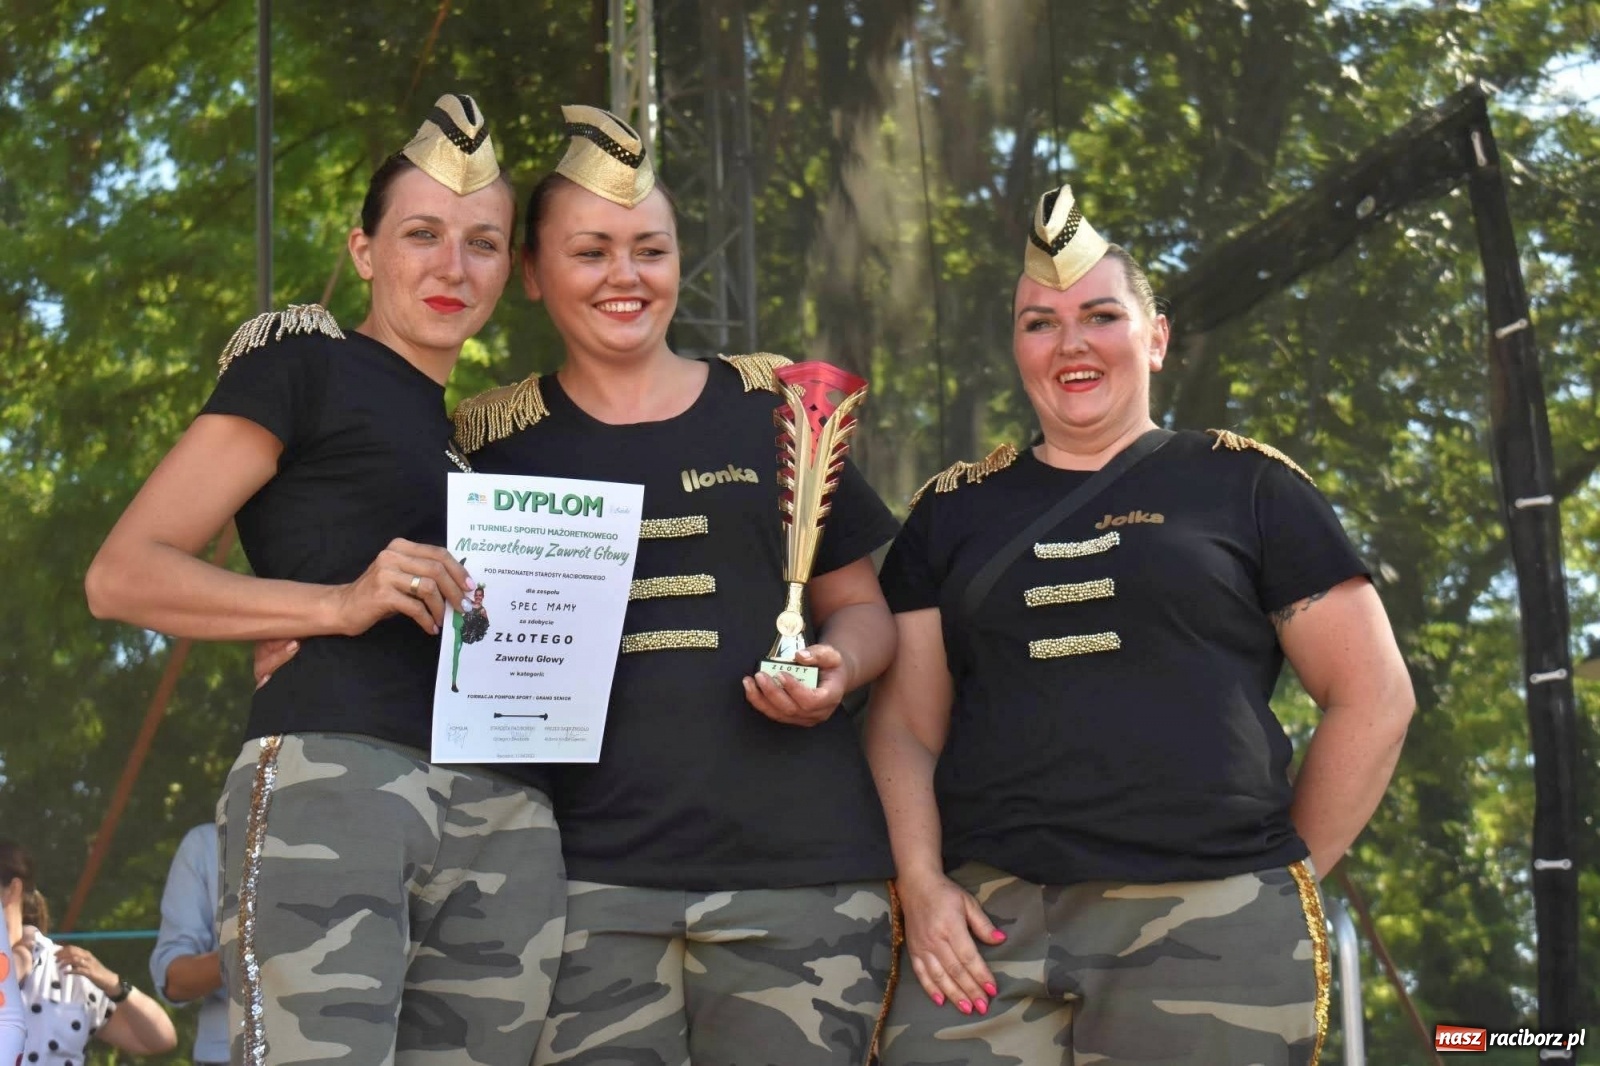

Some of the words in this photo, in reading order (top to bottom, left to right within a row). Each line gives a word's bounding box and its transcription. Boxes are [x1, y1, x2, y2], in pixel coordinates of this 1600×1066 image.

[681, 464, 759, 492] Ilonka
[494, 489, 604, 518] DYPLOM
[1095, 510, 1164, 529] Jolka
[477, 524, 512, 533] TURNIEJ
[514, 526, 546, 535] SPORTU
[547, 527, 618, 540] MAŻORETKOWEGO
[455, 537, 544, 560] Mażoretkowy
[545, 543, 591, 559] Zawrót
[594, 546, 630, 566] Głowy
[498, 569, 534, 577] PATRONATEM
[534, 571, 561, 579] STAROSTY
[562, 572, 606, 581] RACIBORSKIEGO
[510, 600, 538, 611] SPEC
[546, 602, 577, 612] MAMY
[528, 618, 554, 626] zdobycie
[494, 632, 574, 645] ZŁOTEGO
[495, 654, 534, 663] Zawrotu
[536, 655, 565, 666] Głowy
[772, 664, 809, 673] ZŁOTY
